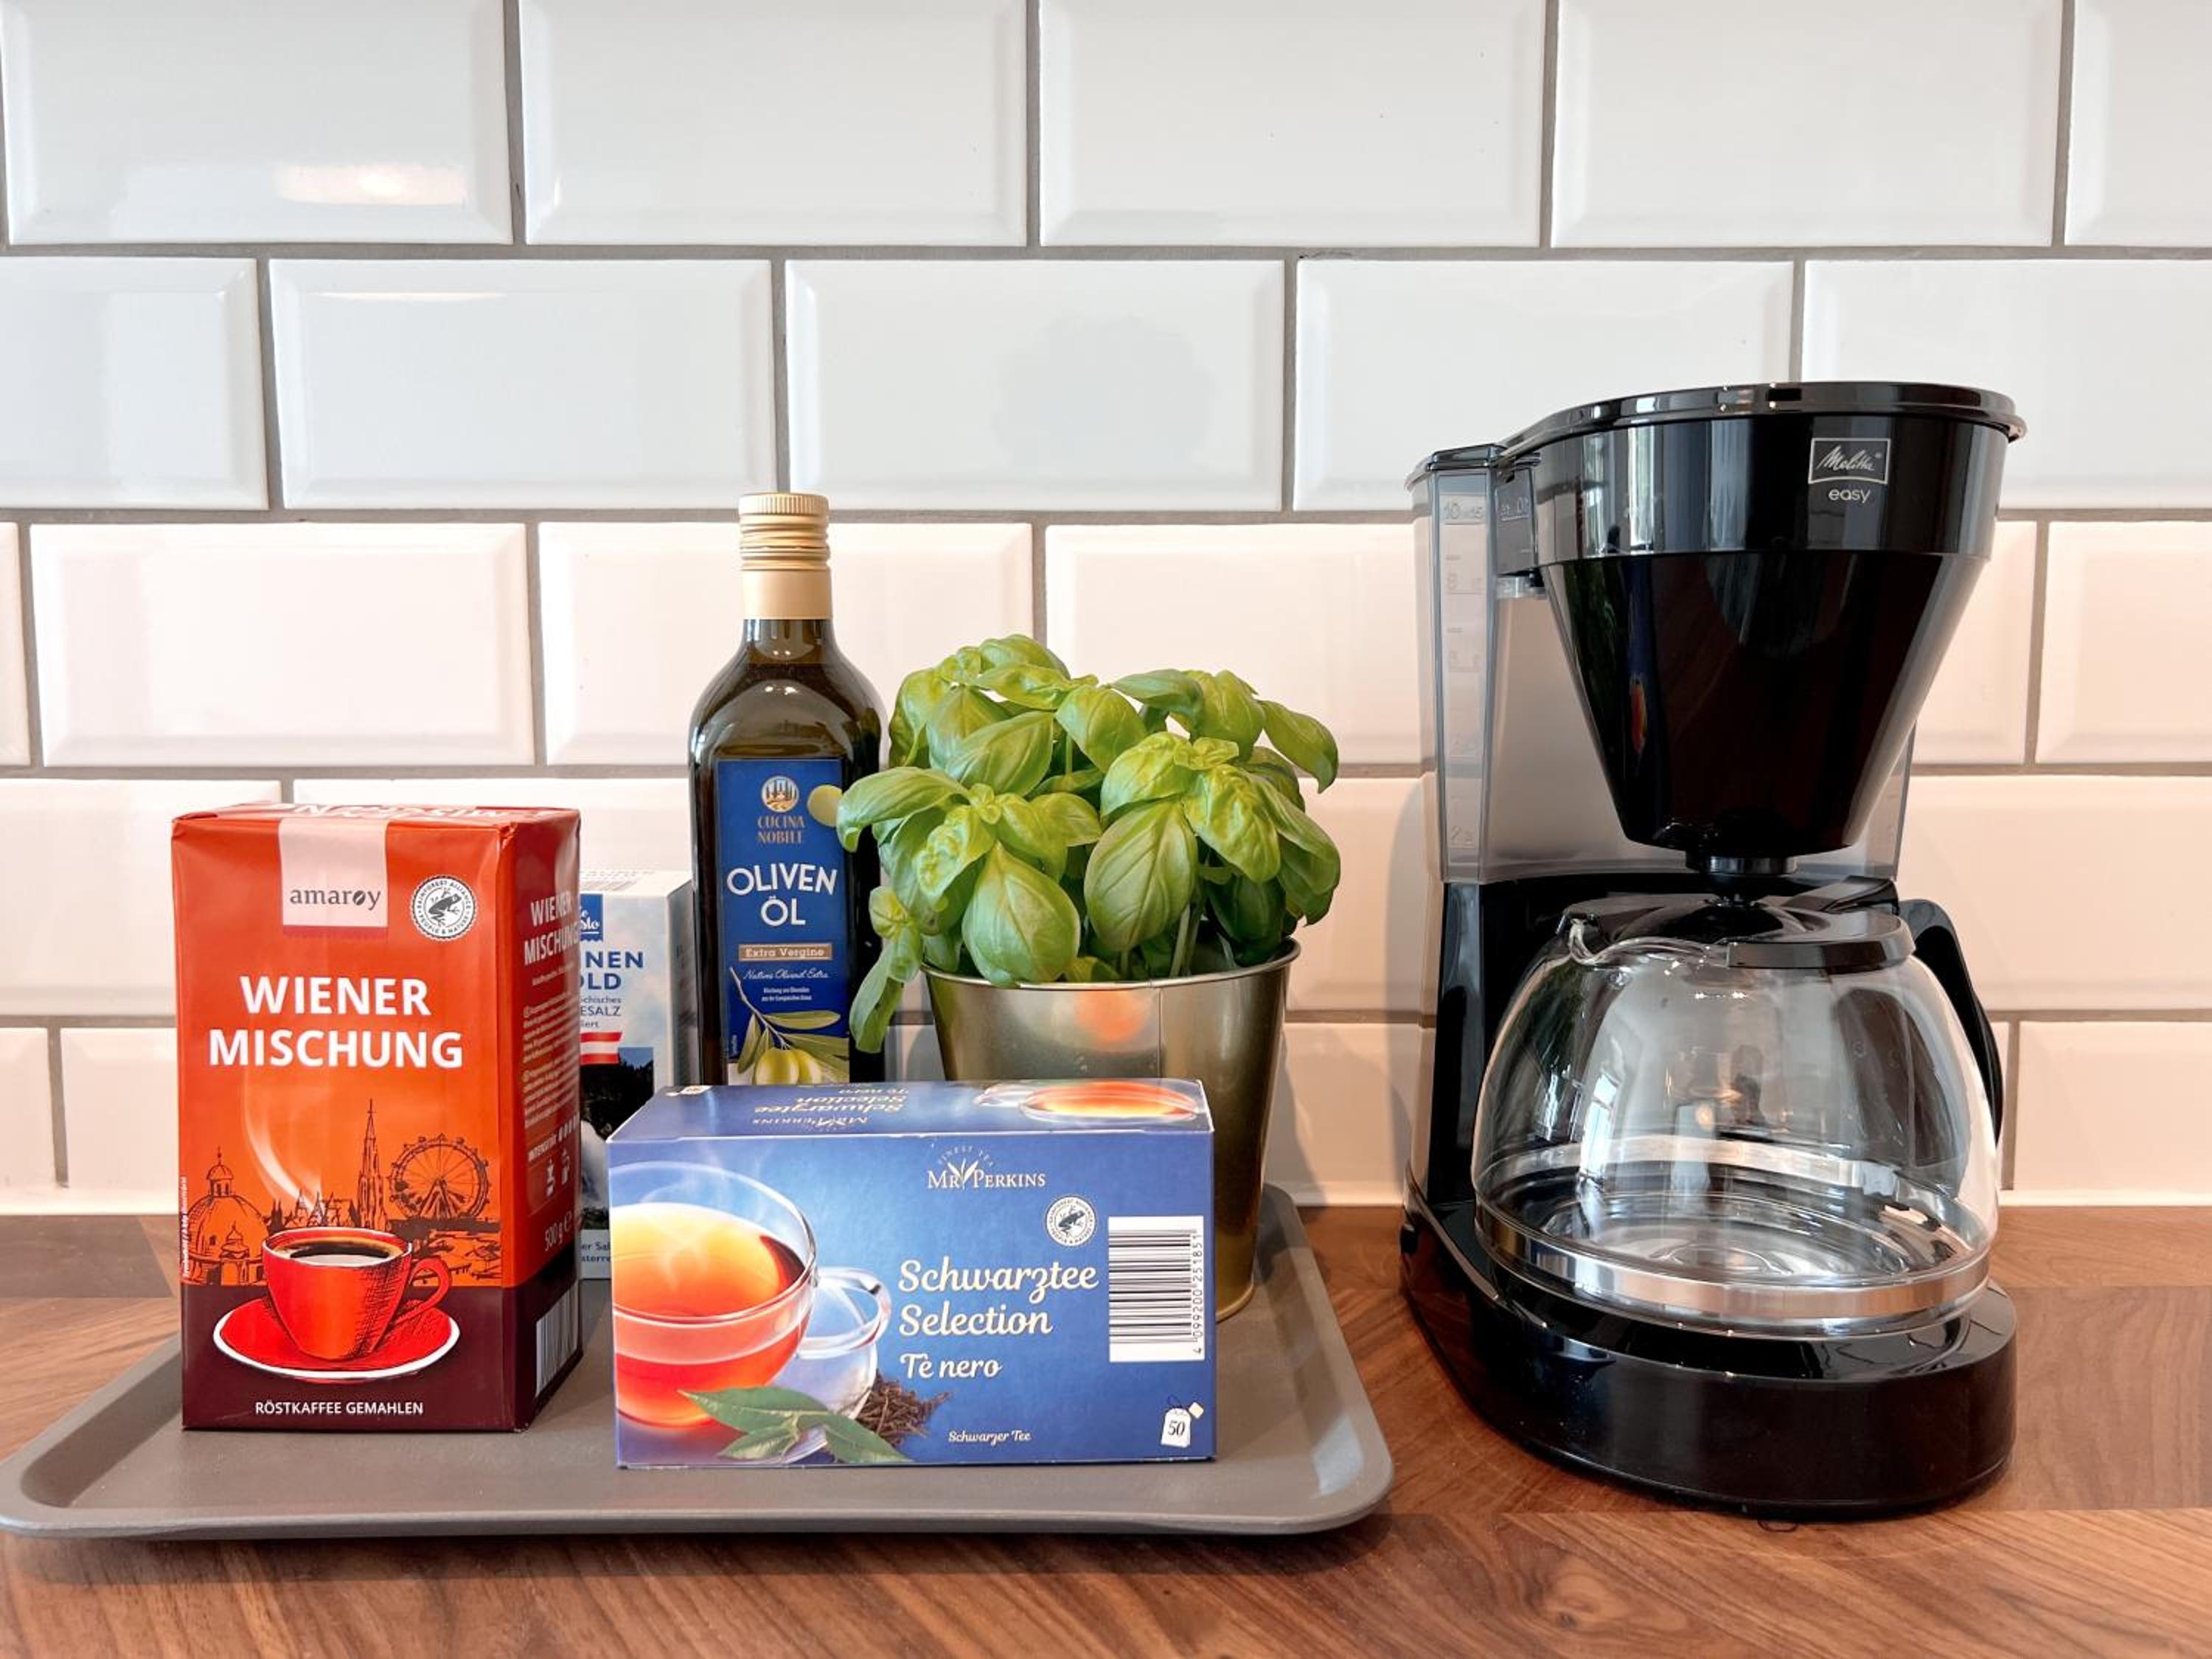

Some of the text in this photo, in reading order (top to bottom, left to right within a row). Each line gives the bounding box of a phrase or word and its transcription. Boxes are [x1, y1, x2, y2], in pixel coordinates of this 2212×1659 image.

[1816, 445, 1875, 471] Melitta
[1829, 489, 1871, 504] easy
[727, 862, 838, 896] OLIVEN
[290, 890, 381, 911] amaroy
[531, 891, 572, 927] WIENER
[761, 896, 806, 927] ÖL
[585, 951, 644, 968] NEN
[745, 947, 776, 957] Extra
[580, 973, 622, 990] LD
[240, 975, 431, 1015] WIENER
[581, 995, 621, 1004] chisches
[580, 1006, 622, 1016] ESALZ
[209, 1029, 463, 1068] MISCHUNG
[897, 1256, 1099, 1304] Schwarztee
[1192, 1232, 1203, 1355] 4 099200 251851
[898, 1300, 1053, 1336] Selection
[939, 1359, 1003, 1378] nero
[255, 1399, 424, 1415] RÖSTKAFFEE GEMAHLEN
[948, 1430, 1032, 1446] Schwarzer Tee
[1167, 1421, 1186, 1436] 50
